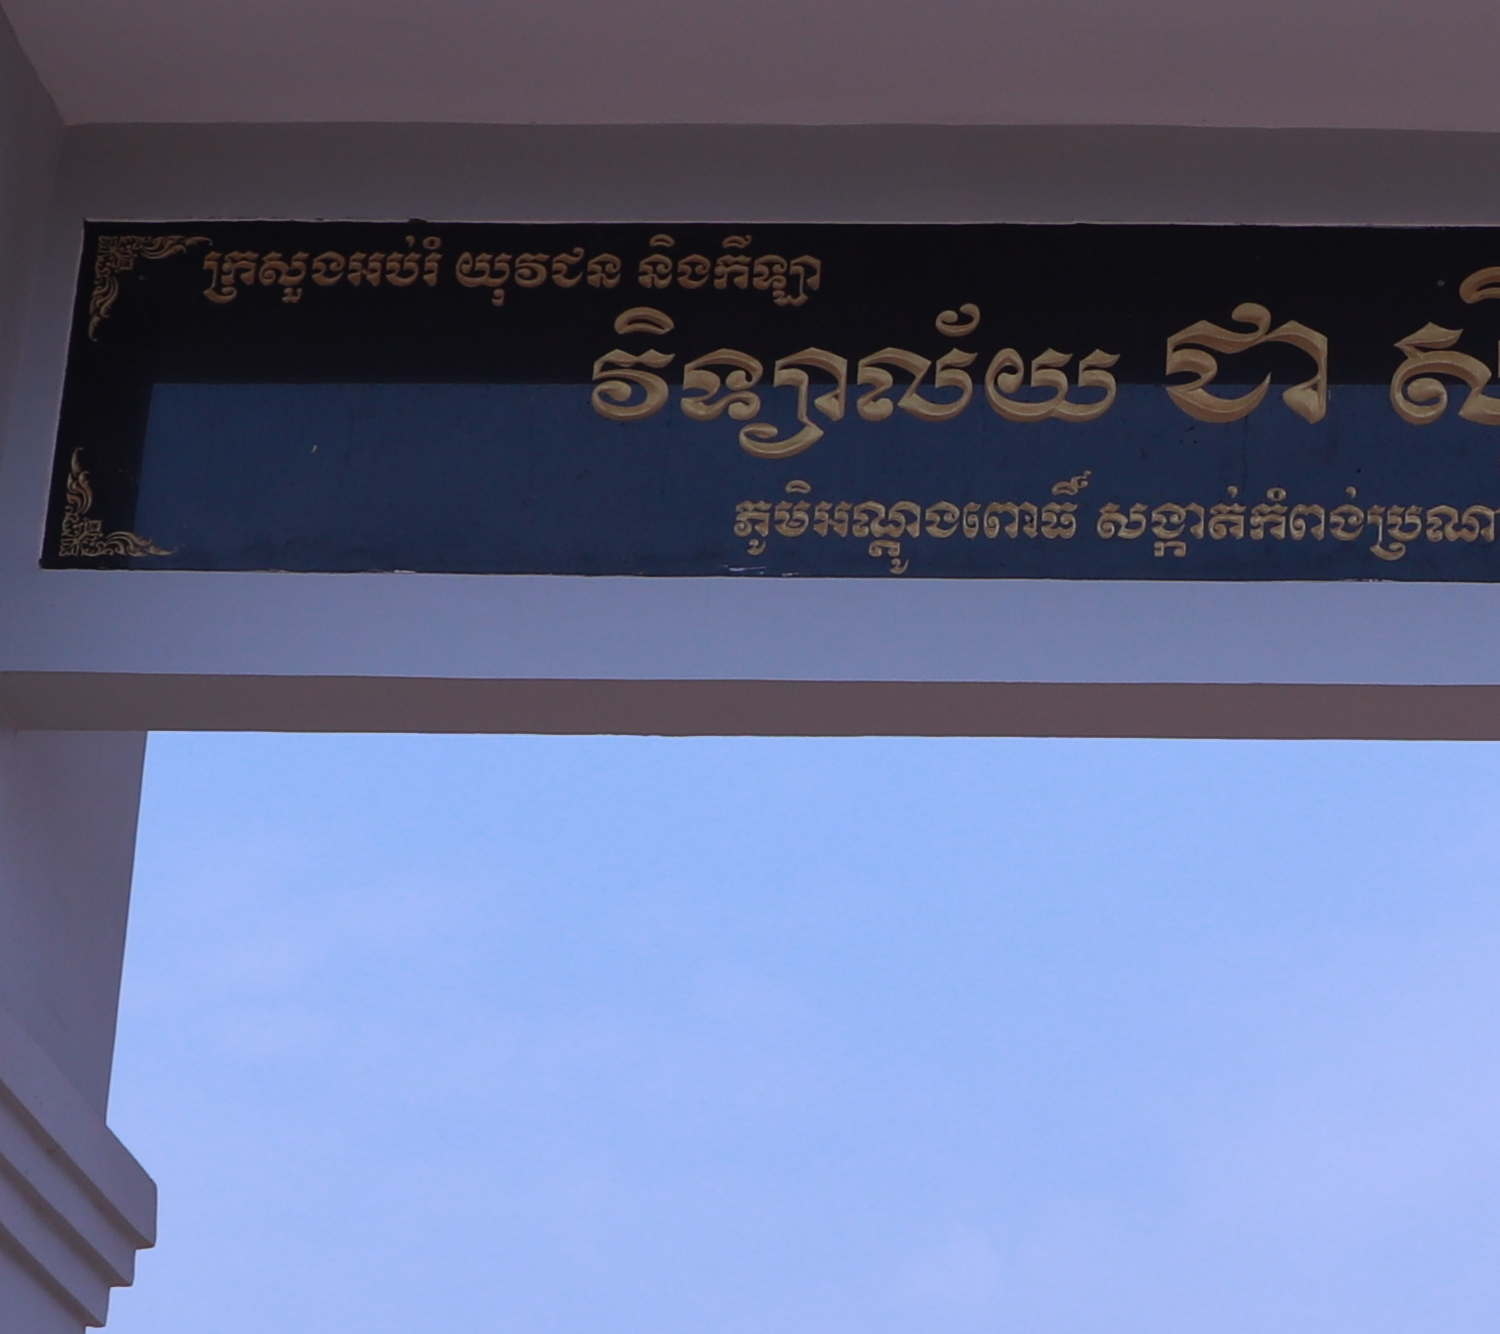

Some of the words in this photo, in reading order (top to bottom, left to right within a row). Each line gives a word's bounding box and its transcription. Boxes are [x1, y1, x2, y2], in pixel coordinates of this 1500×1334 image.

[202, 235, 443, 304] ក្រសួងអប់រំ
[455, 248, 622, 308] យុវជន
[638, 233, 822, 307] និងកីឡា
[591, 305, 1122, 460] វិទ្យាល័យ
[1166, 301, 1329, 425] ជា
